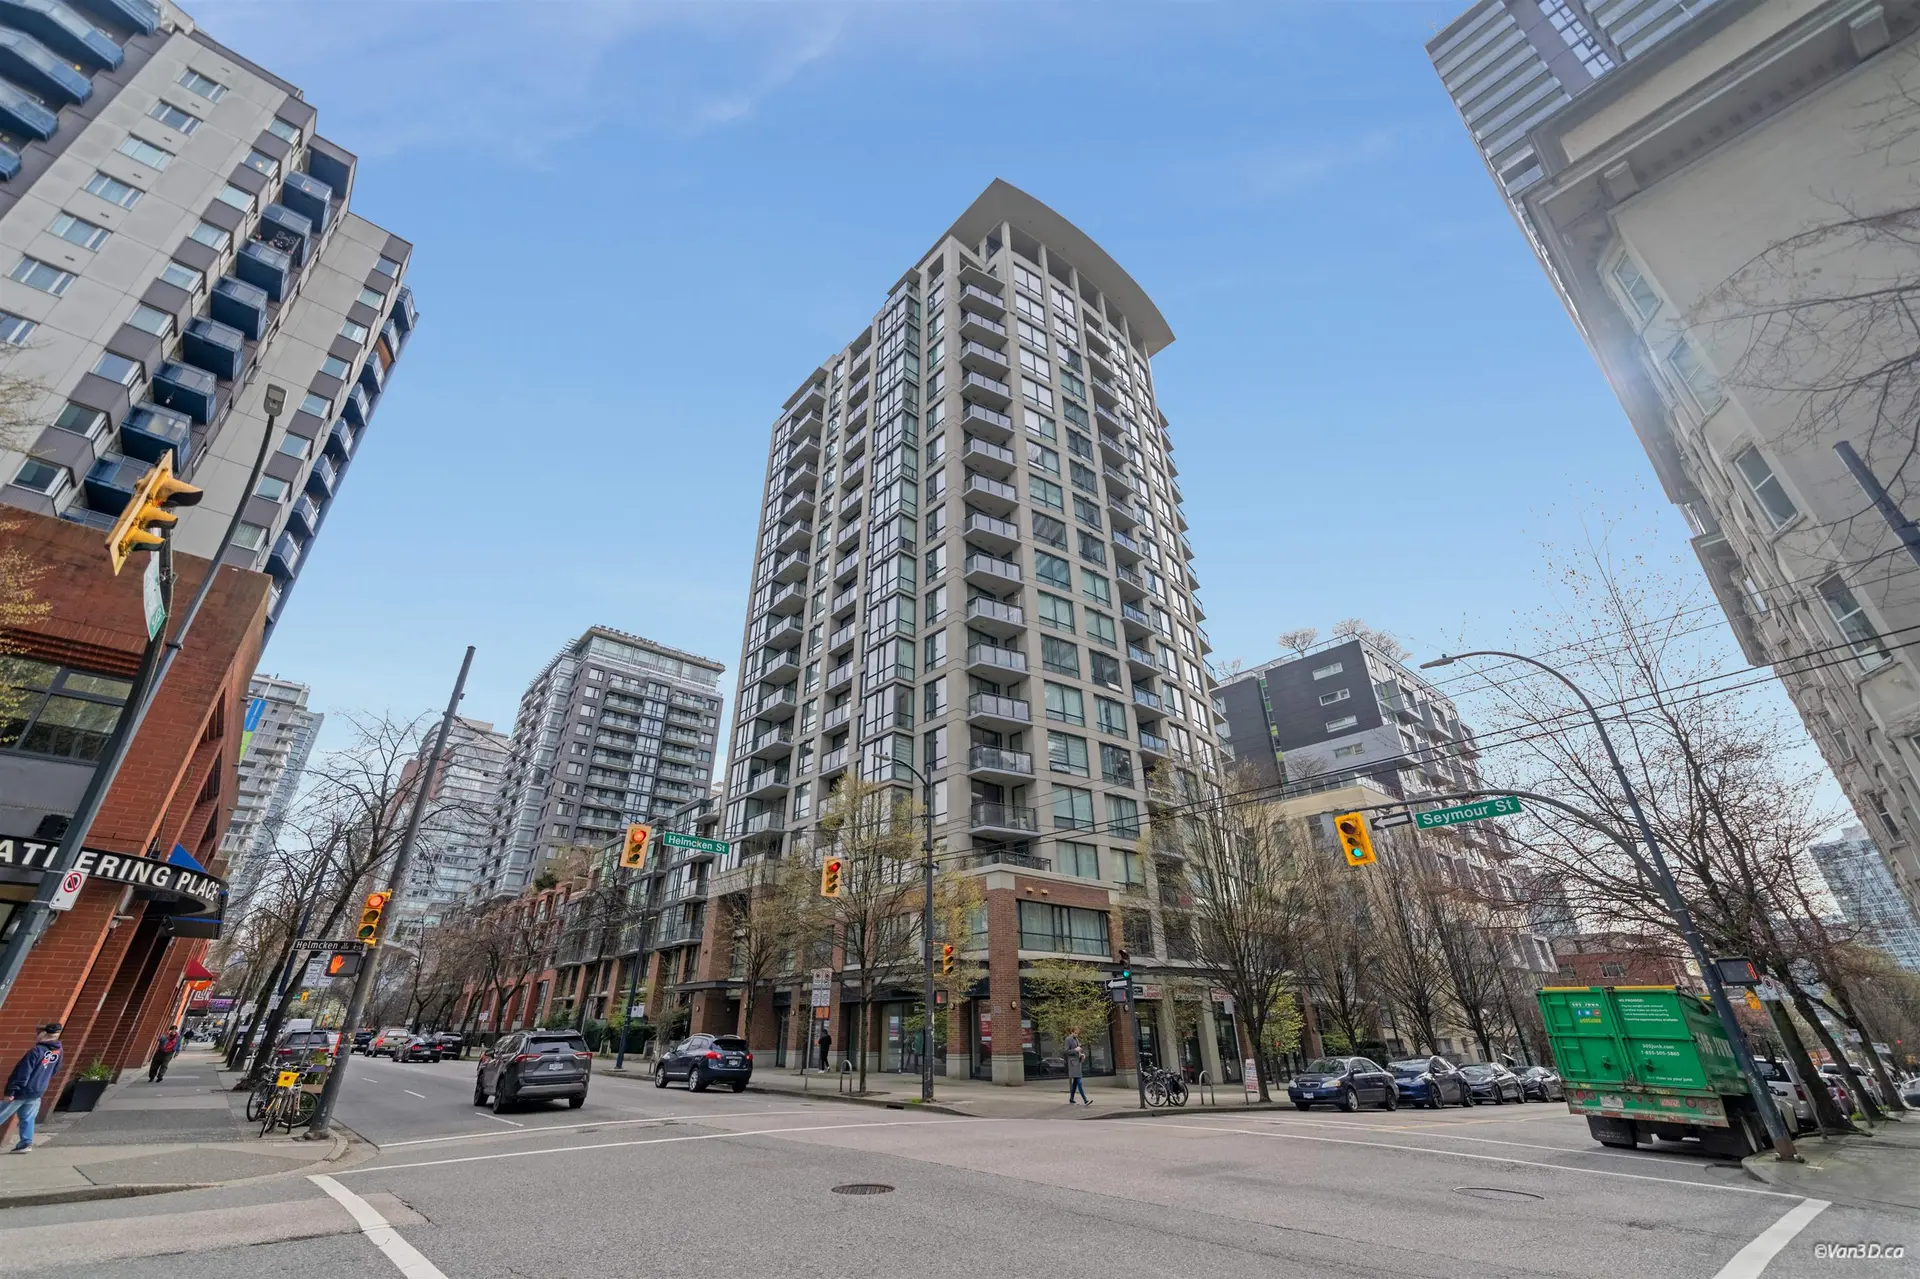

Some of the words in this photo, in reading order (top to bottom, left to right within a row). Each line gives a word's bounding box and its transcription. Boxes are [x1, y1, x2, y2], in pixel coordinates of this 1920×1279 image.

[1422, 805, 1488, 825] Seymour
[1495, 799, 1514, 812] St
[668, 835, 713, 850] Helmcken
[716, 843, 726, 852] St
[174, 871, 220, 901] PLACE
[296, 941, 339, 949] Helmcken
